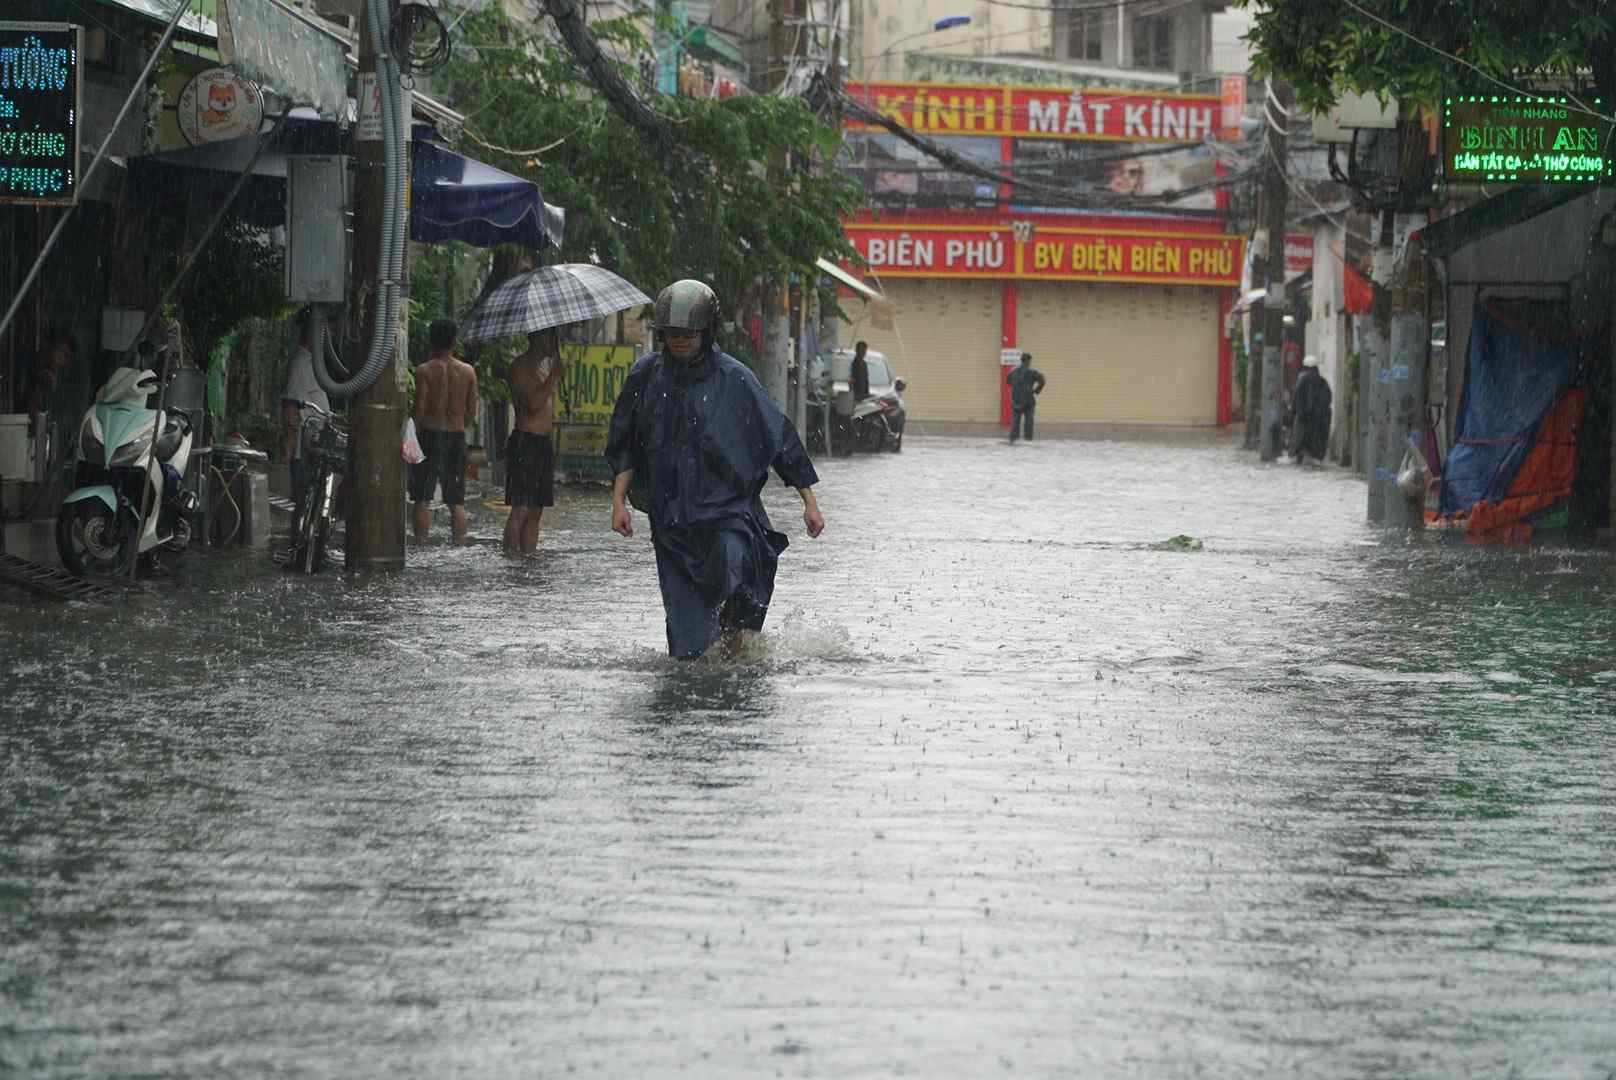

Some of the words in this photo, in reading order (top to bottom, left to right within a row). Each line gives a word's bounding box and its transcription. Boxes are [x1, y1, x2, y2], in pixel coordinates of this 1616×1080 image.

[875, 89, 995, 130] KÍNH
[1027, 89, 1111, 134] MẮT
[1124, 98, 1212, 141] KÍNH
[1523, 107, 1568, 119] NHANG
[1552, 126, 1598, 150] AN
[1569, 153, 1603, 171] CÚNG
[867, 232, 934, 267] BIÊN
[945, 231, 1004, 268] PHỦ
[1033, 242, 1063, 269] BV
[1071, 239, 1122, 276] ĐIỆN
[1130, 241, 1180, 273] BIÊN
[1189, 241, 1232, 276] PHỦ
